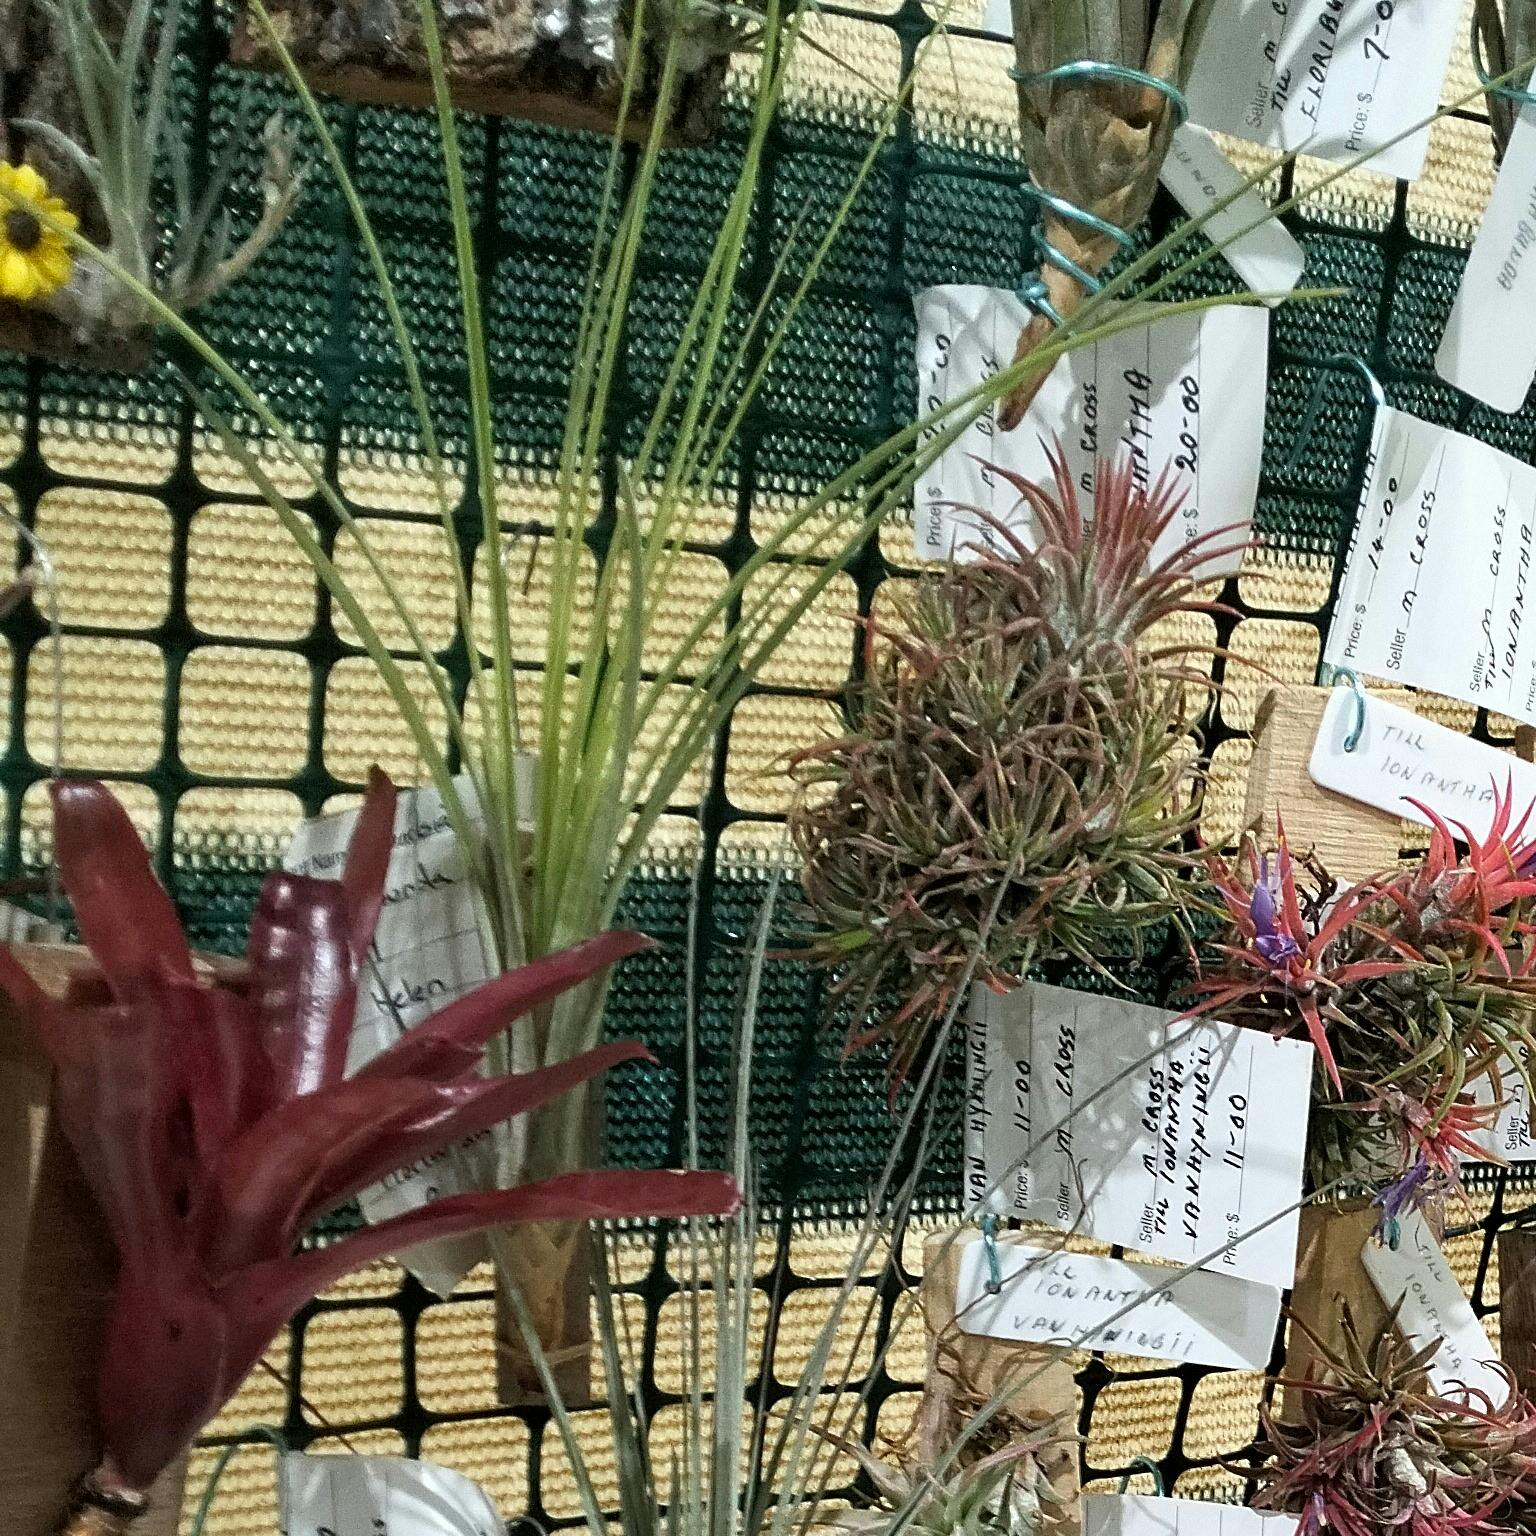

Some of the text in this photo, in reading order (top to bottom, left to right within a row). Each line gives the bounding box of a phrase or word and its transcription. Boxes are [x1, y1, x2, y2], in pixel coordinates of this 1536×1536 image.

[1246, 83, 1268, 128] Seller
[1346, 107, 1367, 150] Price:
[1081, 382, 1098, 453] CROSS
[1173, 375, 1200, 474] 20-00
[1344, 477, 1398, 658] Price: $ 14-00
[1386, 489, 1435, 671] Seller M CROSS
[1469, 505, 1507, 693] Seller CROSS
[1501, 524, 1533, 678] IONANTHA
[1525, 672, 1536, 712] Price:
[1057, 1025, 1074, 1097] CROSS
[1014, 1061, 1030, 1209] Price: 11-00
[1140, 1068, 1164, 1244] Seller CROSS
[1160, 1061, 1184, 1184] IONANTHA
[1223, 1094, 1247, 1169] 11-00
[1505, 1116, 1520, 1151] Seller
[970, 1157, 985, 1201] VAN
[1057, 1183, 1069, 1221] Seller
[1226, 1214, 1239, 1223] $
